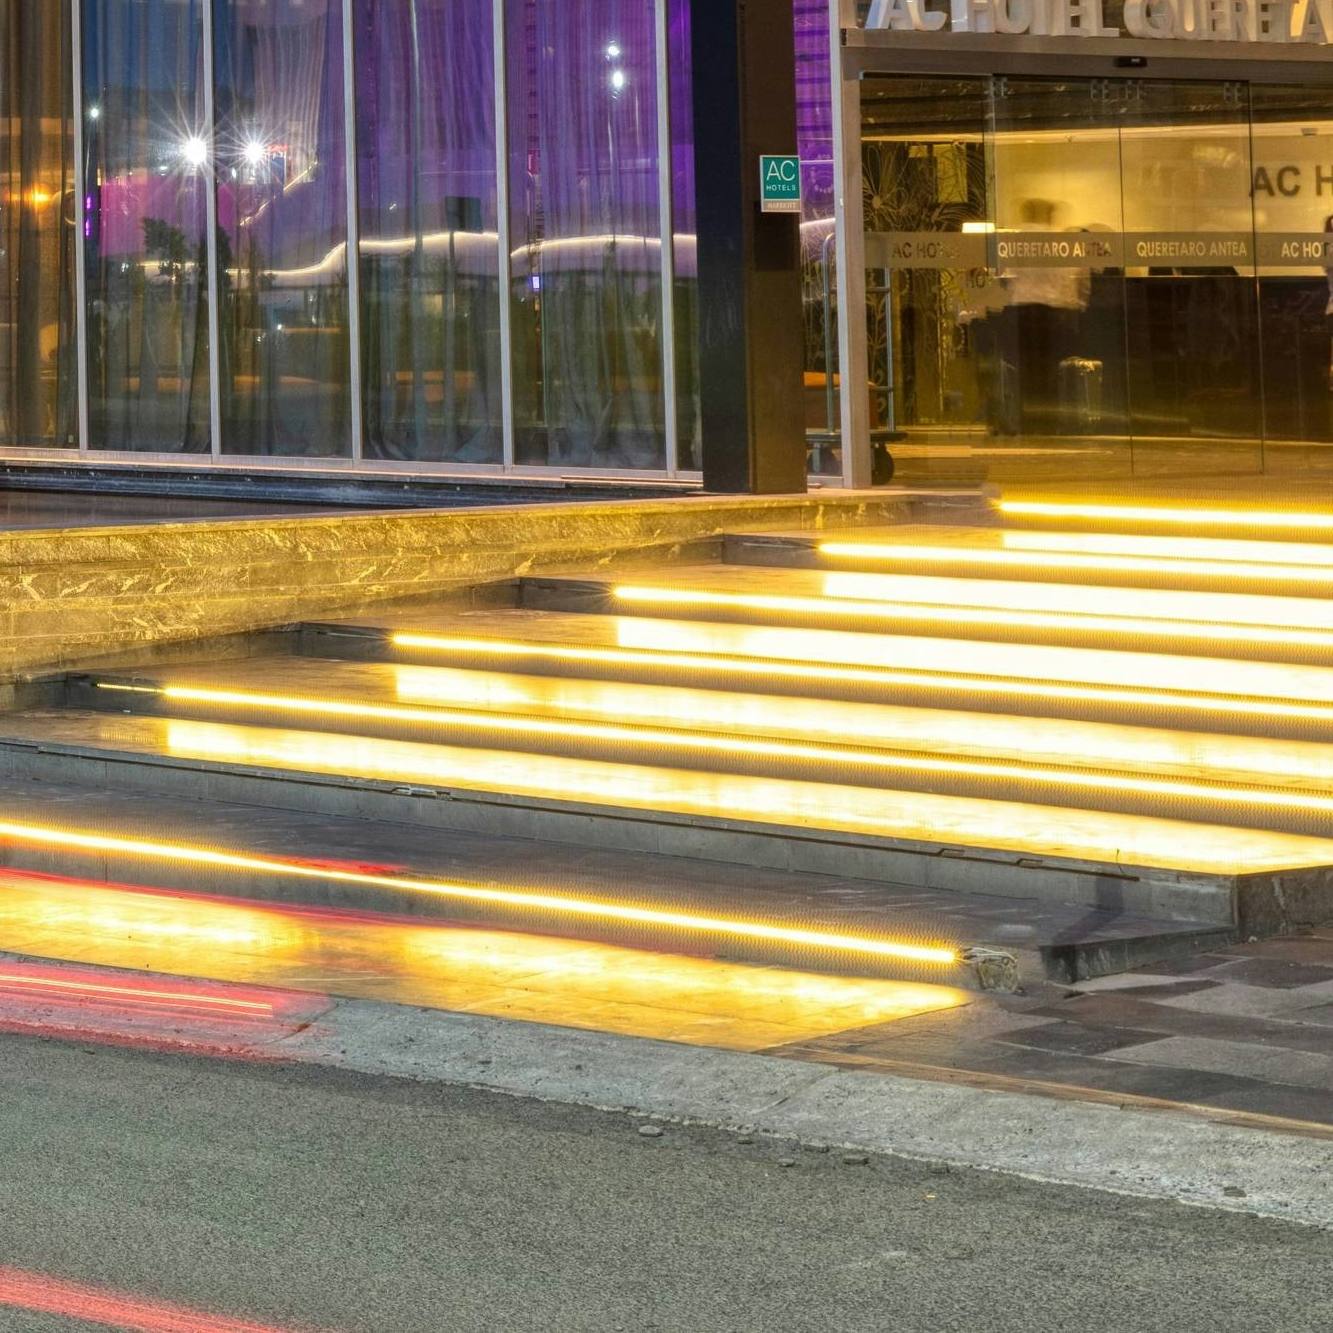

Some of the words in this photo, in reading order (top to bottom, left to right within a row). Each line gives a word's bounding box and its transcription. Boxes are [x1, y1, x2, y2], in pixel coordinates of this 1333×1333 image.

[766, 160, 795, 181] AC
[1250, 165, 1301, 197] AC
[893, 242, 912, 258] AC
[997, 242, 1070, 258] QUERETARO
[1136, 242, 1206, 258] QUERETARO
[1209, 242, 1247, 257] ANTEA
[1280, 242, 1300, 258] AC
